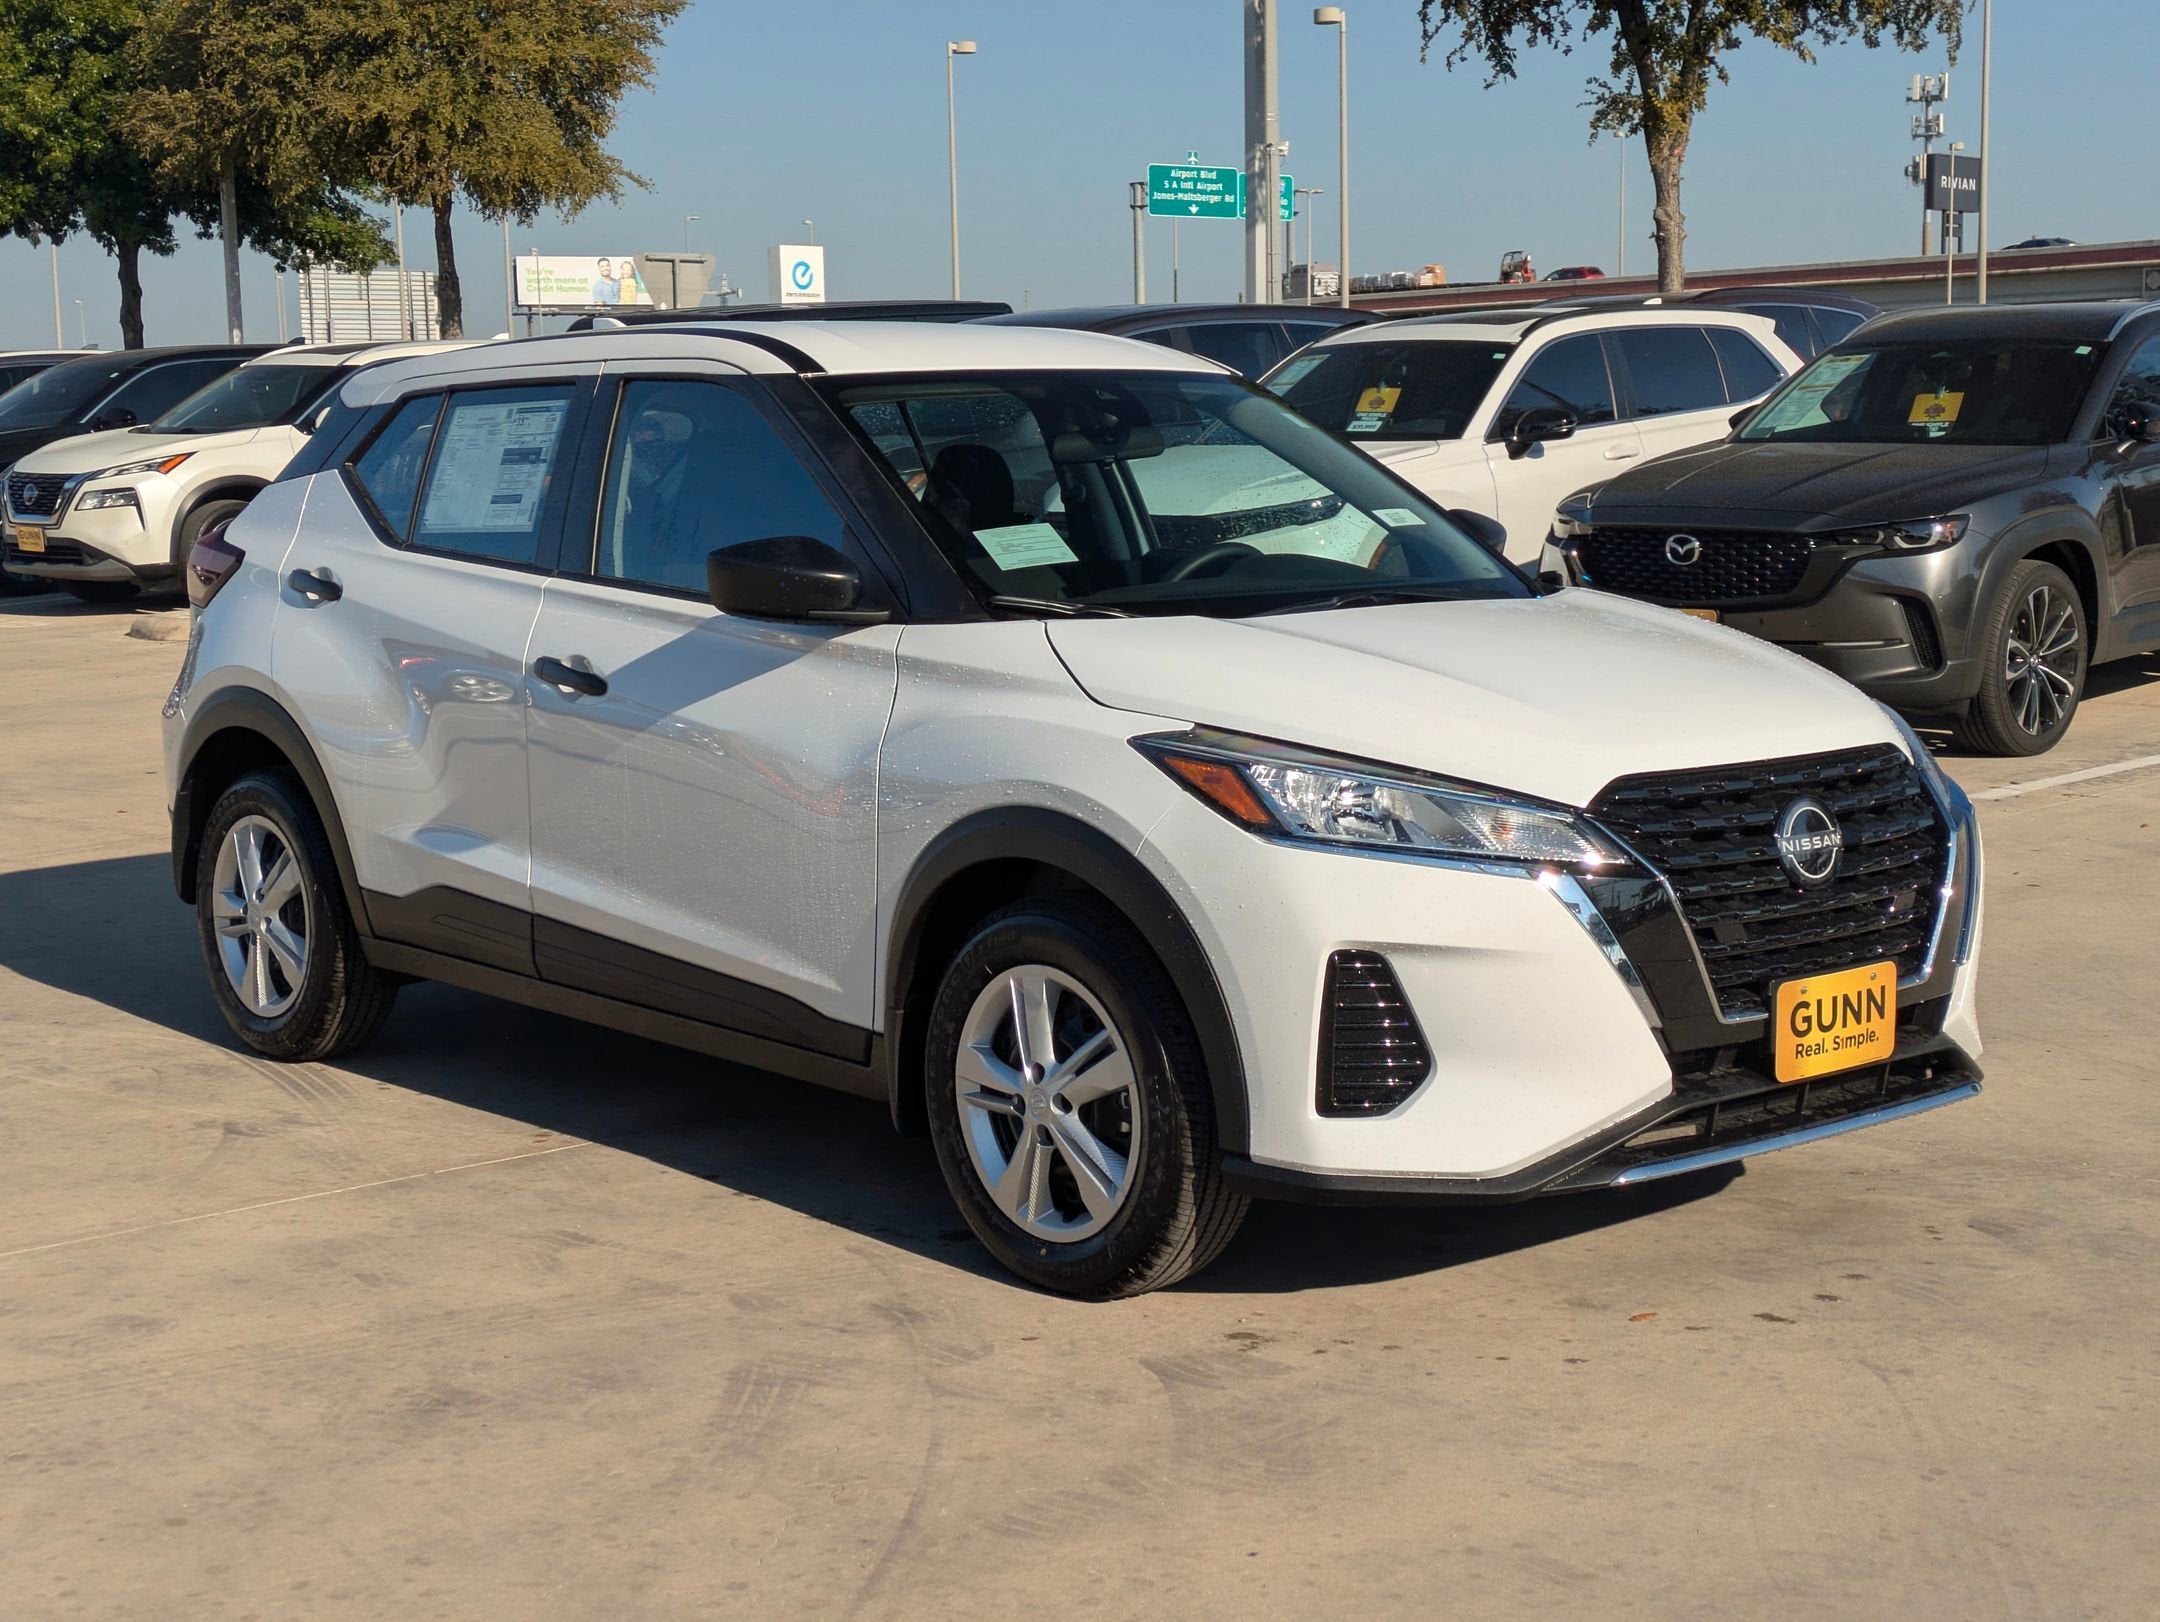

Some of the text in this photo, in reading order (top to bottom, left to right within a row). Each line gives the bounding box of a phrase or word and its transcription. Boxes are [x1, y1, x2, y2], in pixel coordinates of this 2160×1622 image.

[1170, 169, 1217, 179] Airport Blvd
[1164, 180, 1224, 192] S A Intl Airport
[1941, 175, 1976, 191] RIVIAN
[1224, 194, 1235, 203] Rd
[1782, 832, 1841, 852] NISSAN
[1790, 985, 1885, 1038] GUNN
[1795, 1037, 1829, 1059] Real.
